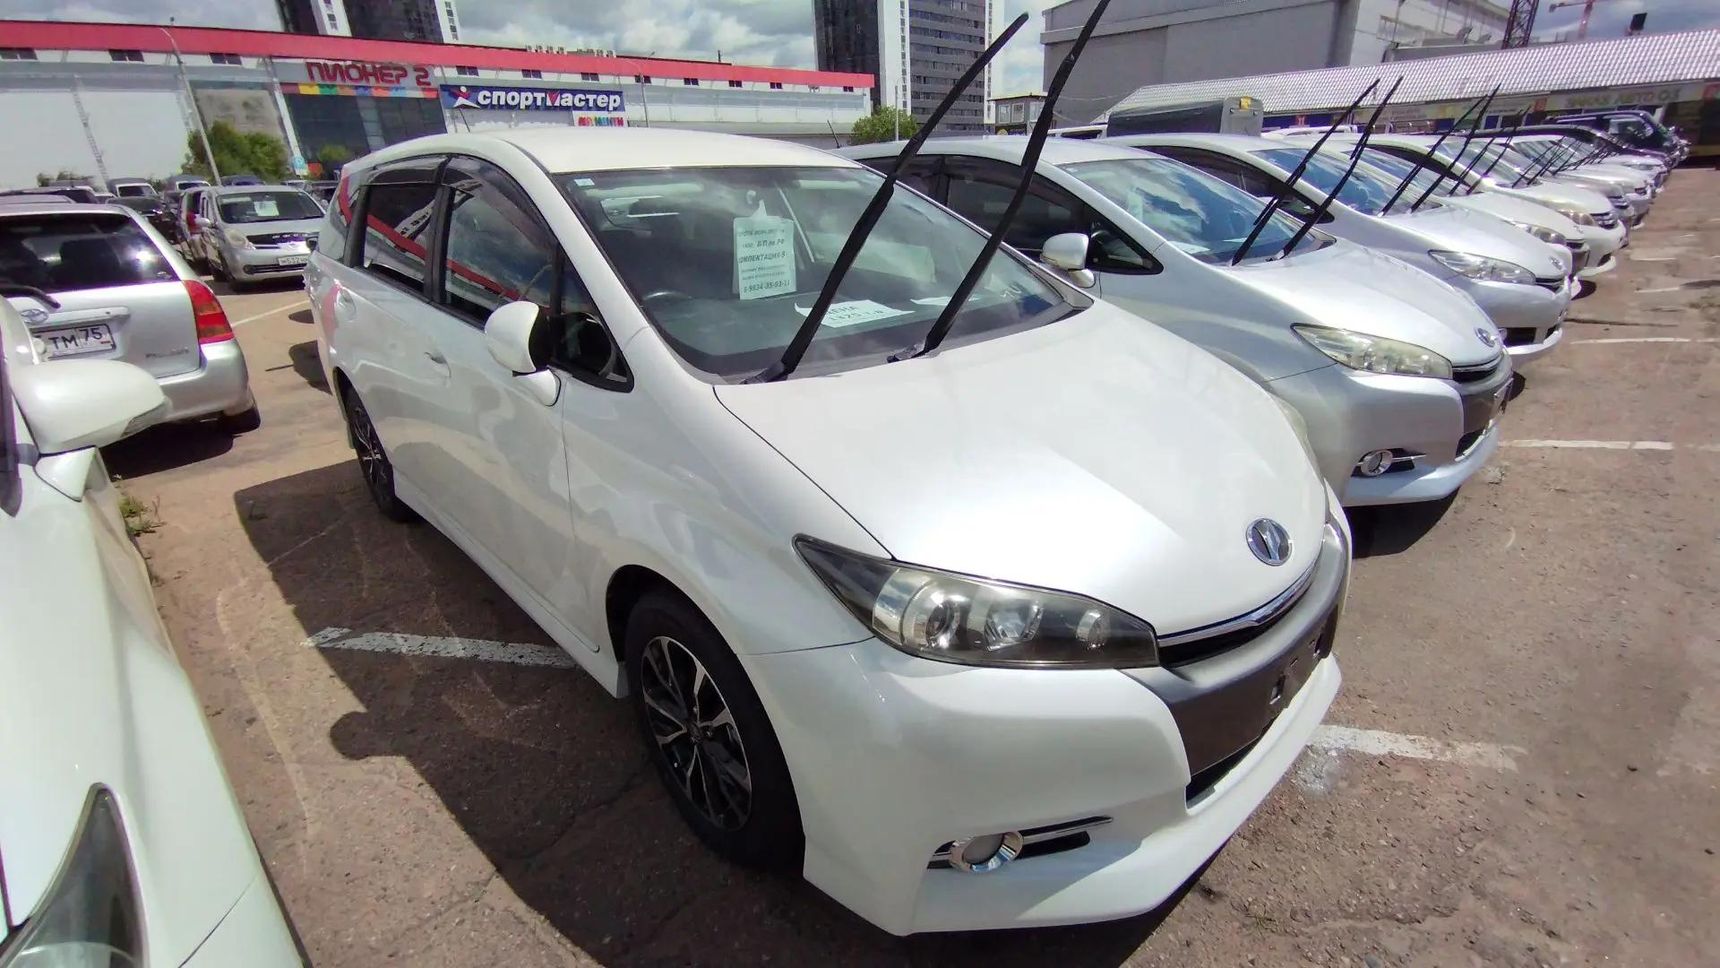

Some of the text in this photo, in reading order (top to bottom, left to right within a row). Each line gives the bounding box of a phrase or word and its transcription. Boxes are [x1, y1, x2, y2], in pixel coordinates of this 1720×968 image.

[305, 61, 432, 86] ПИОНЕР 2
[477, 89, 622, 111] спортмастер
[79, 327, 103, 342] 75
